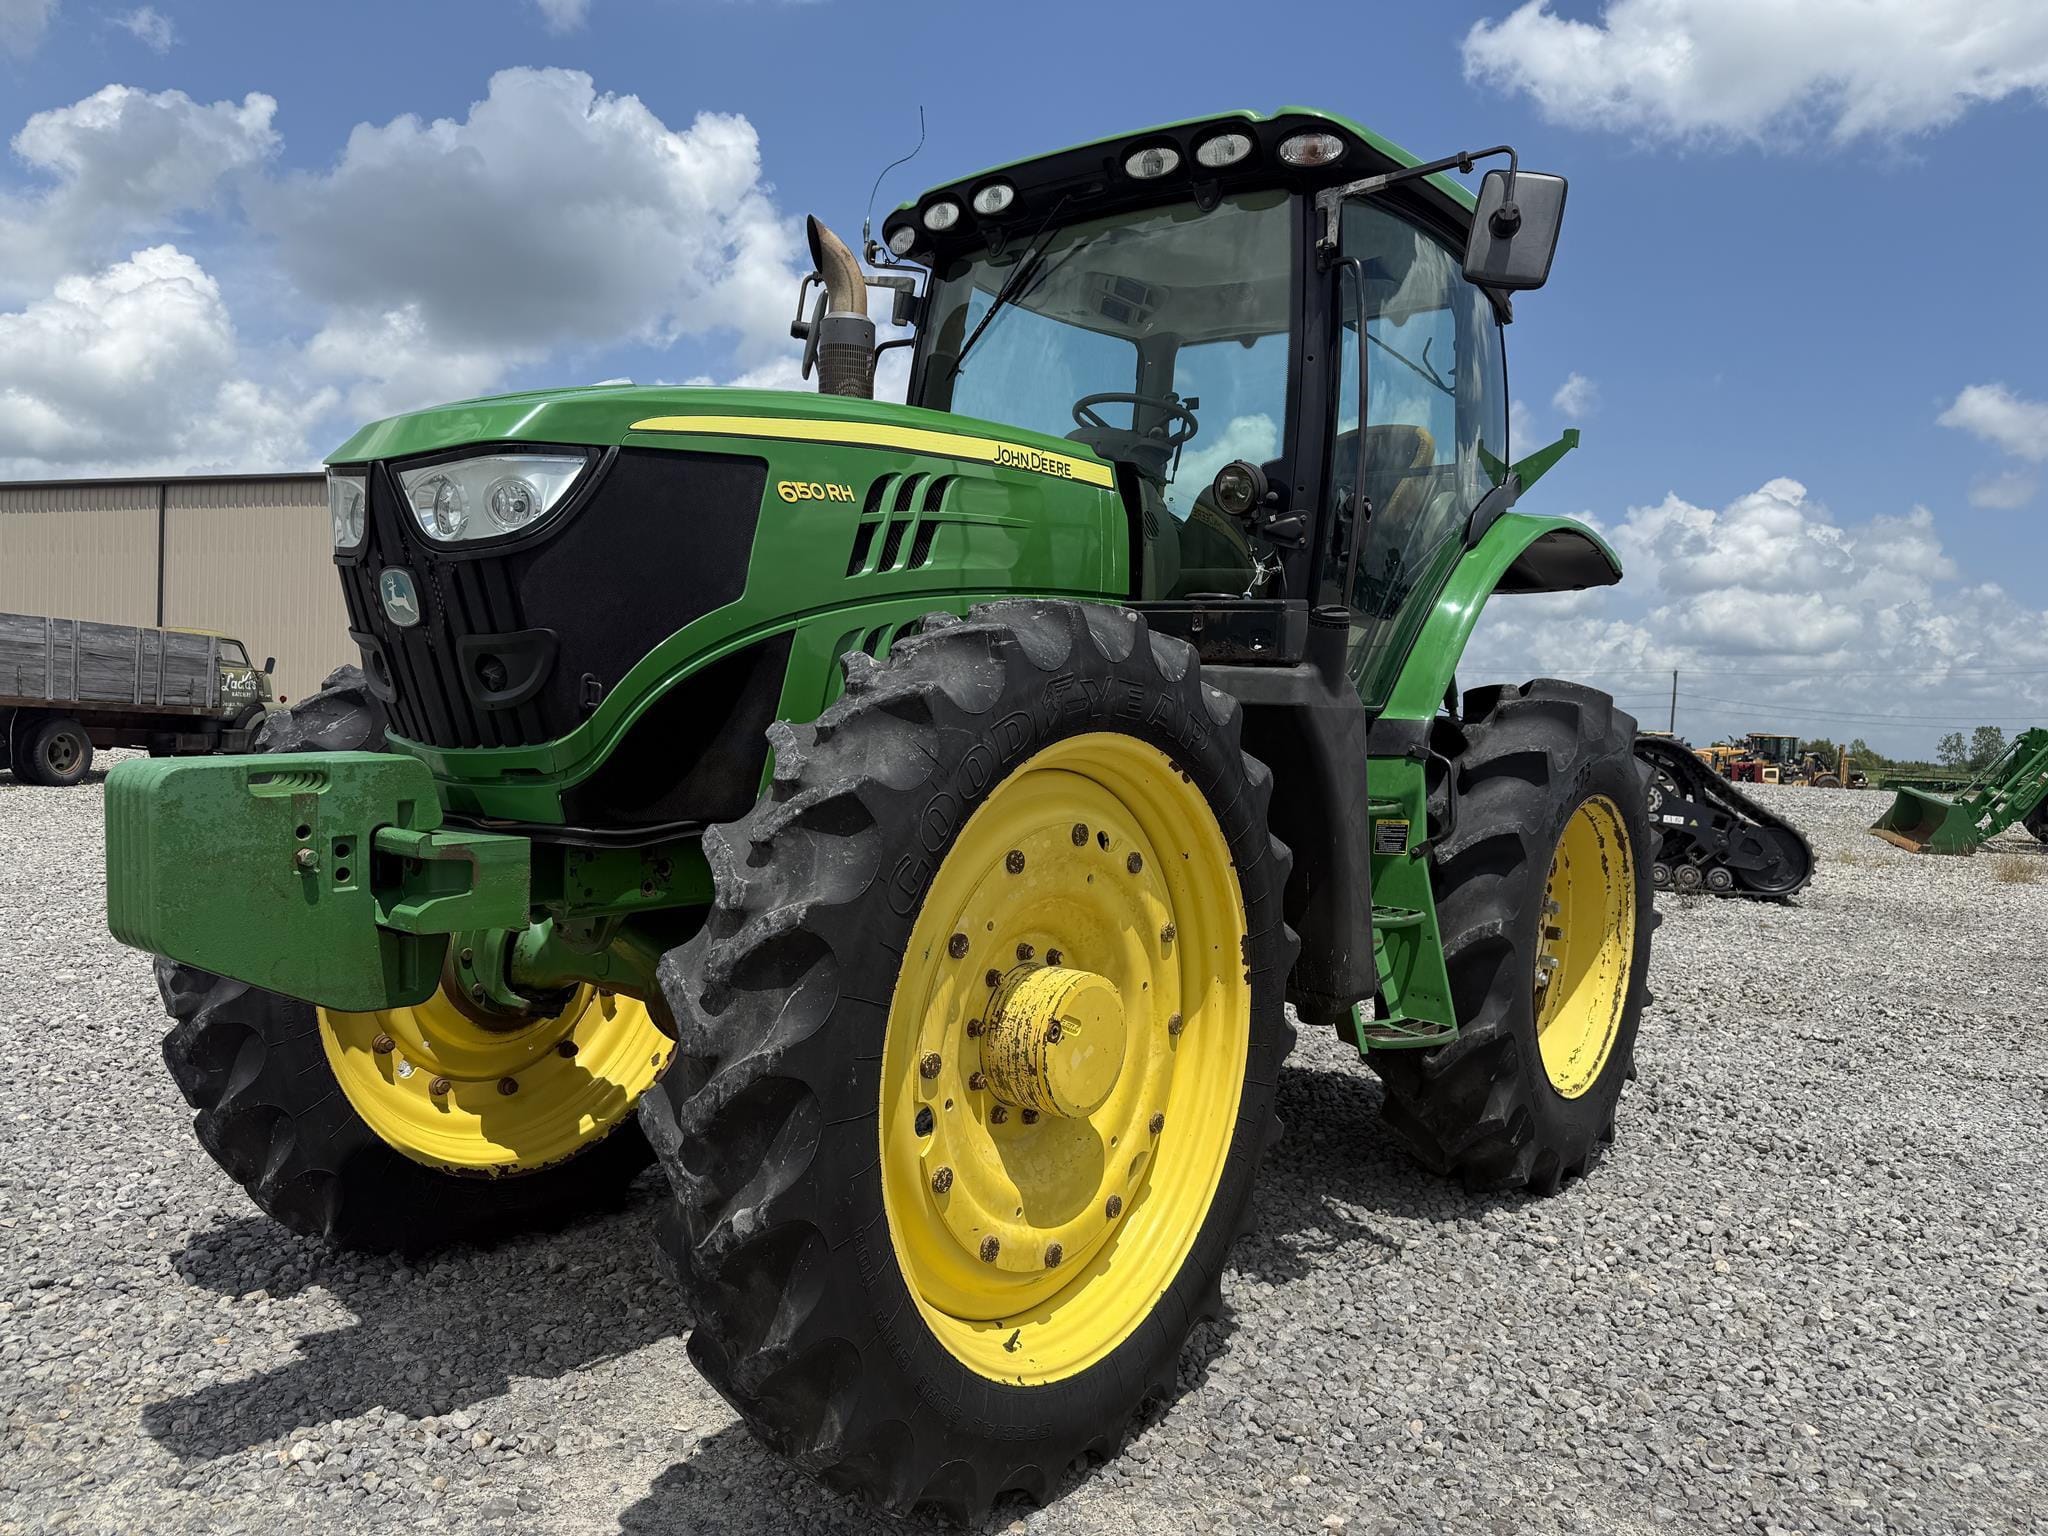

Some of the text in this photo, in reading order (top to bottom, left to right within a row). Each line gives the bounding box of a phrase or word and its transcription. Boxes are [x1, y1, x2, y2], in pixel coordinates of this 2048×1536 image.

[994, 445, 1072, 476] JOHN DEERE
[777, 480, 856, 503] 6150 RH
